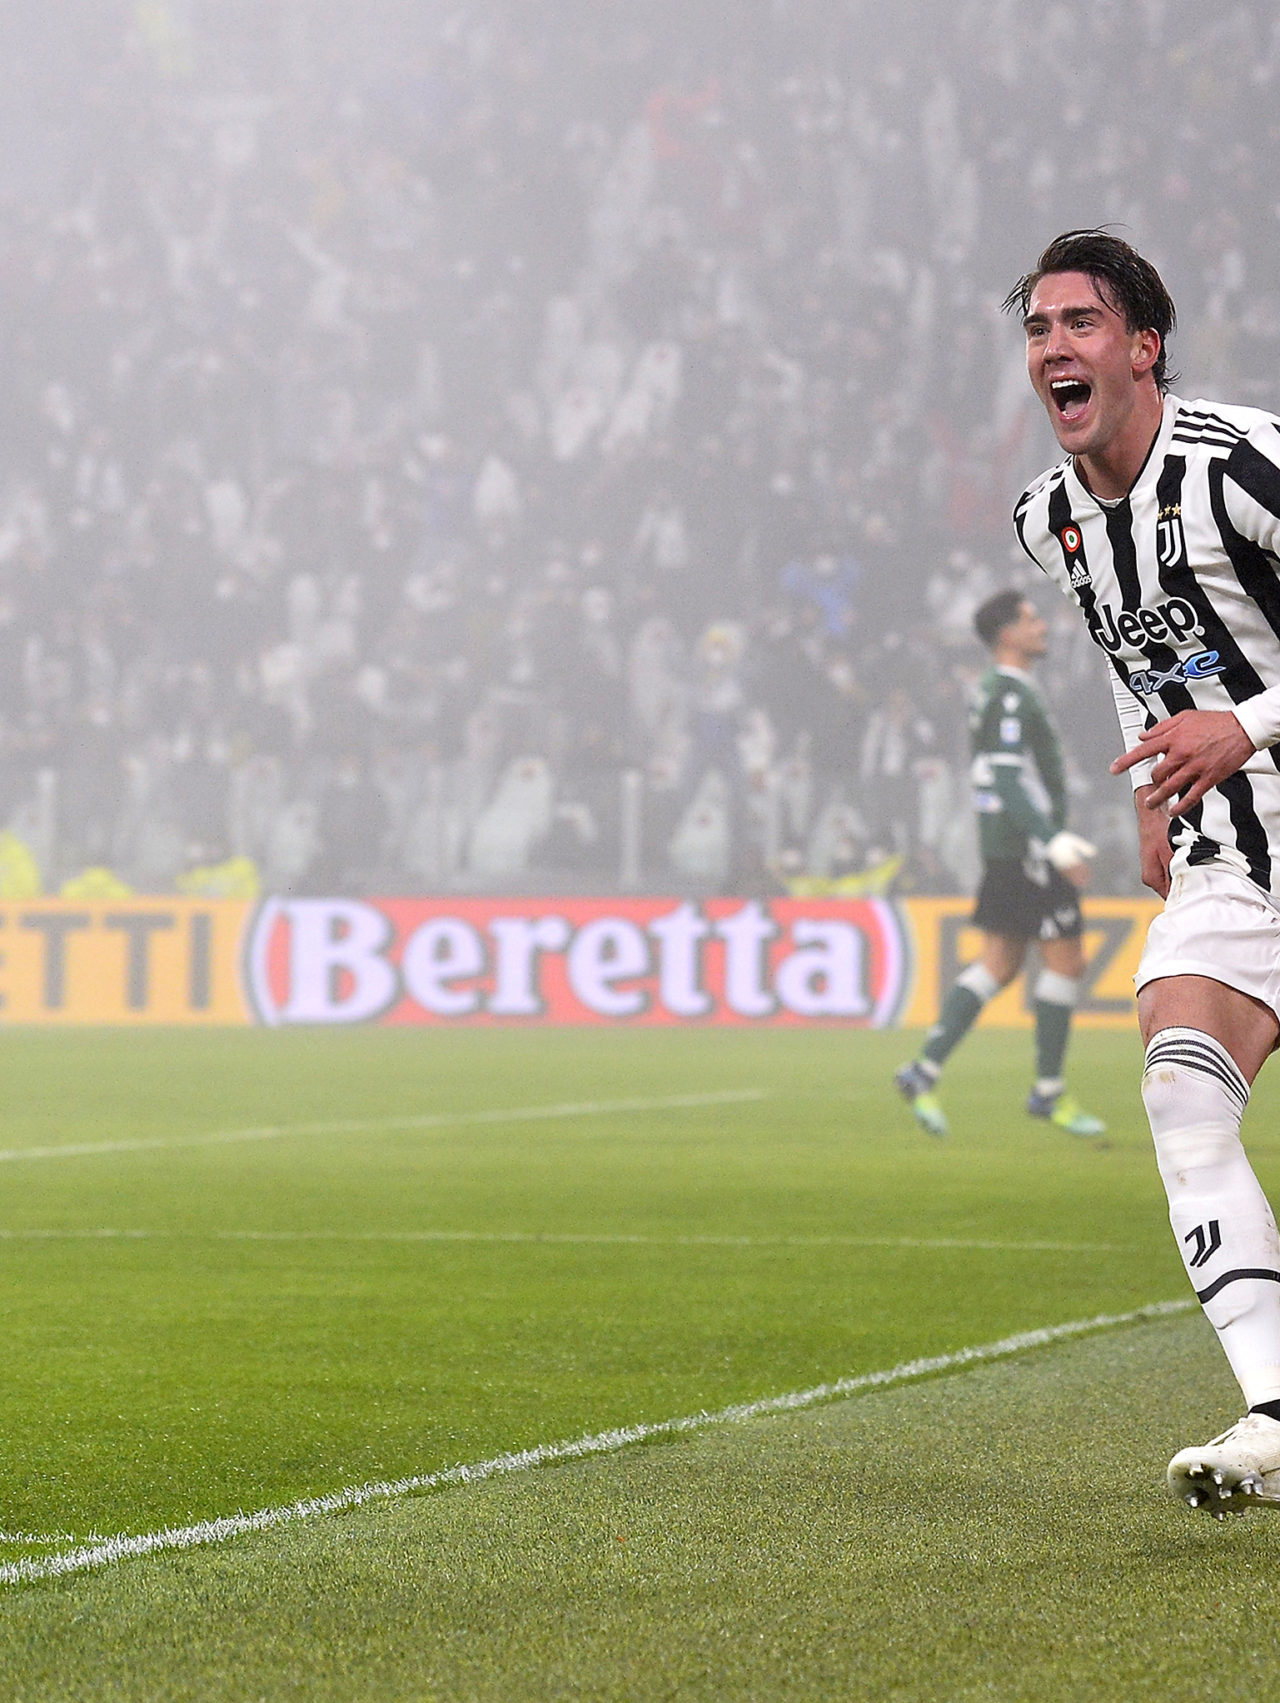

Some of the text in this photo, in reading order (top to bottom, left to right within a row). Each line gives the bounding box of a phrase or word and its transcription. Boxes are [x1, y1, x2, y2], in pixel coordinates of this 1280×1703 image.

[1095, 597, 1200, 655] Jeep
[0, 911, 214, 1011] TTI
[278, 898, 872, 1025] Beretta
